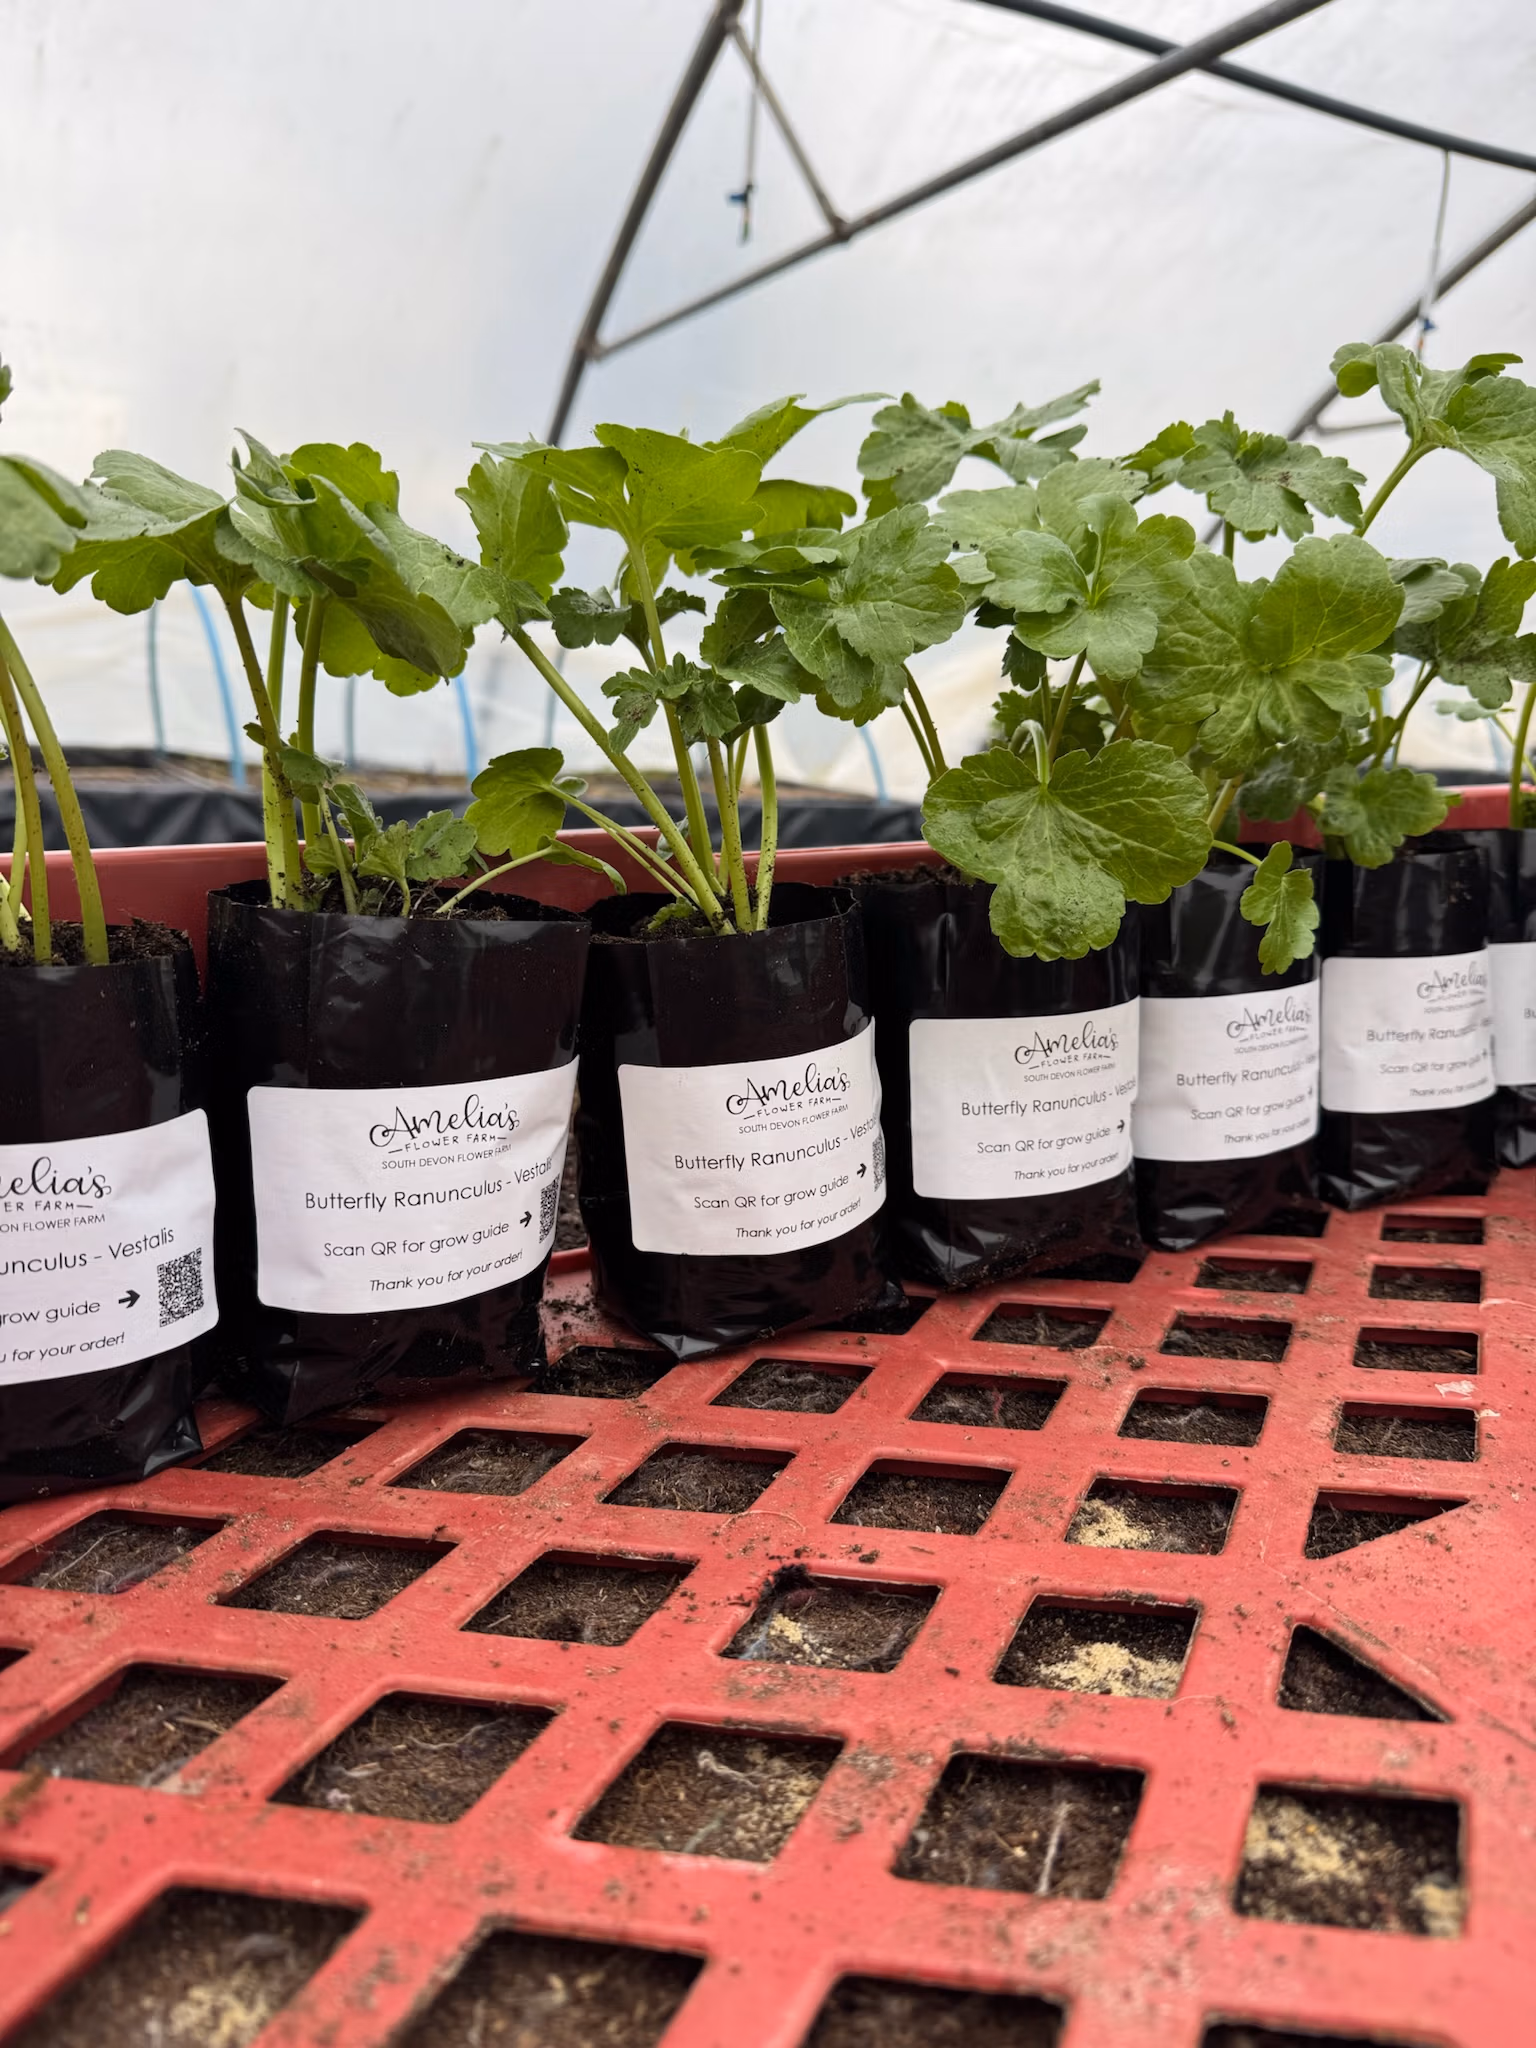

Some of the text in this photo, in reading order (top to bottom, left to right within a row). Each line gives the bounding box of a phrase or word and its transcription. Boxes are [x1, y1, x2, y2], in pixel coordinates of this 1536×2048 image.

[1014, 1021, 1119, 1064] Amelia's
[1367, 1029, 1425, 1043] Butterfly
[1041, 1052, 1103, 1068] FLOWER FARM
[1050, 1071, 1076, 1081] DEVON
[1077, 1066, 1100, 1076] FLOWER
[726, 1063, 851, 1115] Amelia's
[1177, 1071, 1238, 1087] Butterfly
[756, 1096, 832, 1118] FLOWER FARM
[961, 1101, 1027, 1117] Butterfly
[1033, 1091, 1107, 1113] Ranunculus
[1191, 1109, 1222, 1120] Scan
[1225, 1107, 1243, 1118] QR
[1246, 1106, 1261, 1115] for
[369, 1093, 520, 1147] Amelia's
[738, 1104, 849, 1134] SOUTH DEVON FLOWER FARM
[405, 1134, 496, 1152] FLOWER FARM
[977, 1126, 1111, 1154] Scan QR for grow guide
[1224, 1134, 1253, 1144] Thank
[382, 1159, 416, 1170] SOUTH
[419, 1155, 455, 1168] DEVON
[457, 1149, 494, 1162] FLOWER
[674, 1154, 745, 1172] Butterfly
[750, 1135, 841, 1167] Ranunculus
[0, 1156, 112, 1199] elia's
[1014, 1170, 1045, 1180] Thank
[1047, 1168, 1066, 1178] you
[1068, 1163, 1080, 1173] for
[1081, 1159, 1098, 1171] your
[305, 1192, 388, 1212] Butterfly
[394, 1178, 503, 1208] Ranunculus
[694, 1174, 849, 1209] Scan QR for grow guide
[35, 1200, 74, 1212] FARM
[736, 1197, 862, 1238] Thank you for your order!
[23, 1217, 71, 1232] FLOWER
[74, 1213, 106, 1227] FARM
[0, 1252, 88, 1275] unculus
[108, 1227, 175, 1259] Vestalis
[324, 1222, 510, 1257] Scan QR for grow guide
[369, 1248, 524, 1292] Thank you for your order!
[0, 1300, 101, 1328] row guide
[12, 1349, 36, 1362] for
[39, 1344, 77, 1361] your
[79, 1331, 125, 1352] order!
